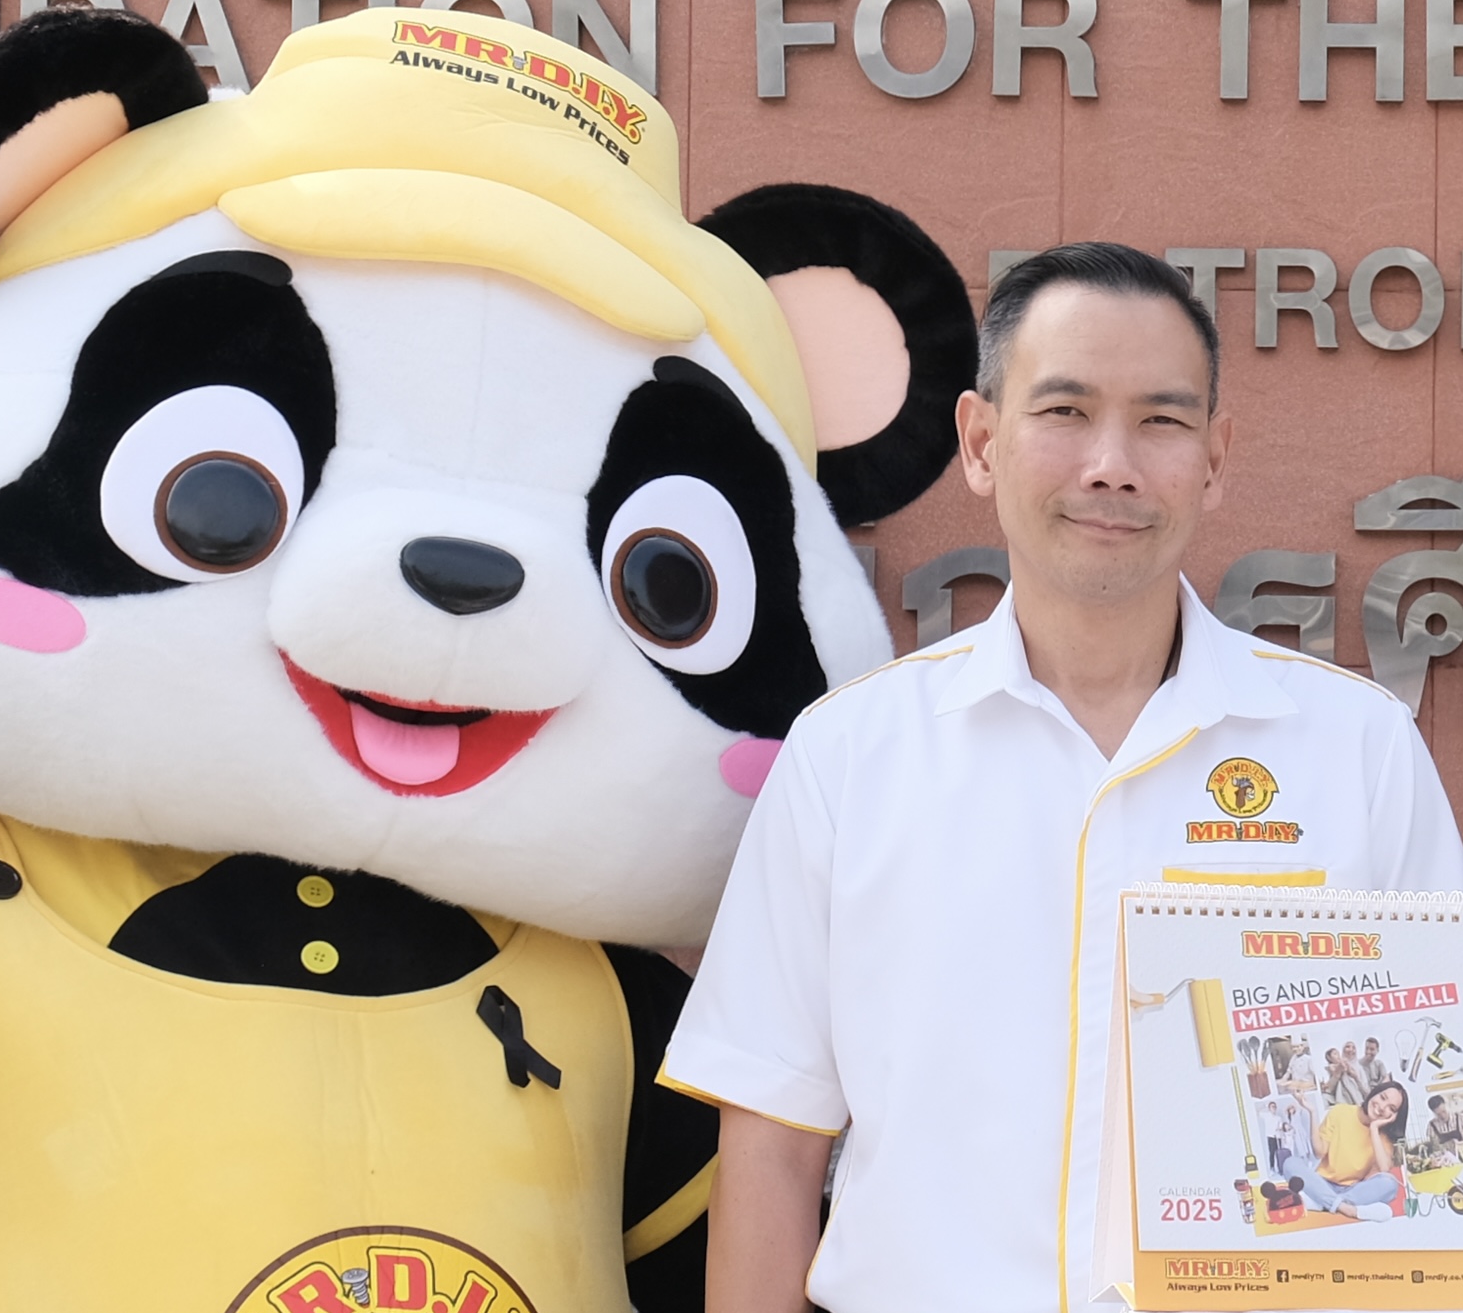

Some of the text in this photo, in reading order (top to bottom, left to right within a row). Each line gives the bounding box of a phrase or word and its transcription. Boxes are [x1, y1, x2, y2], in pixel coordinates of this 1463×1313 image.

[389, 50, 630, 167] Always Low Prices
[1233, 970, 1399, 1008] BIG AND SMALL
[1238, 986, 1455, 1030] MR.D.I.Y. HAS IT ALL
[1161, 1198, 1223, 1222] 2025
[1167, 1282, 1269, 1293] Always Low Prices
